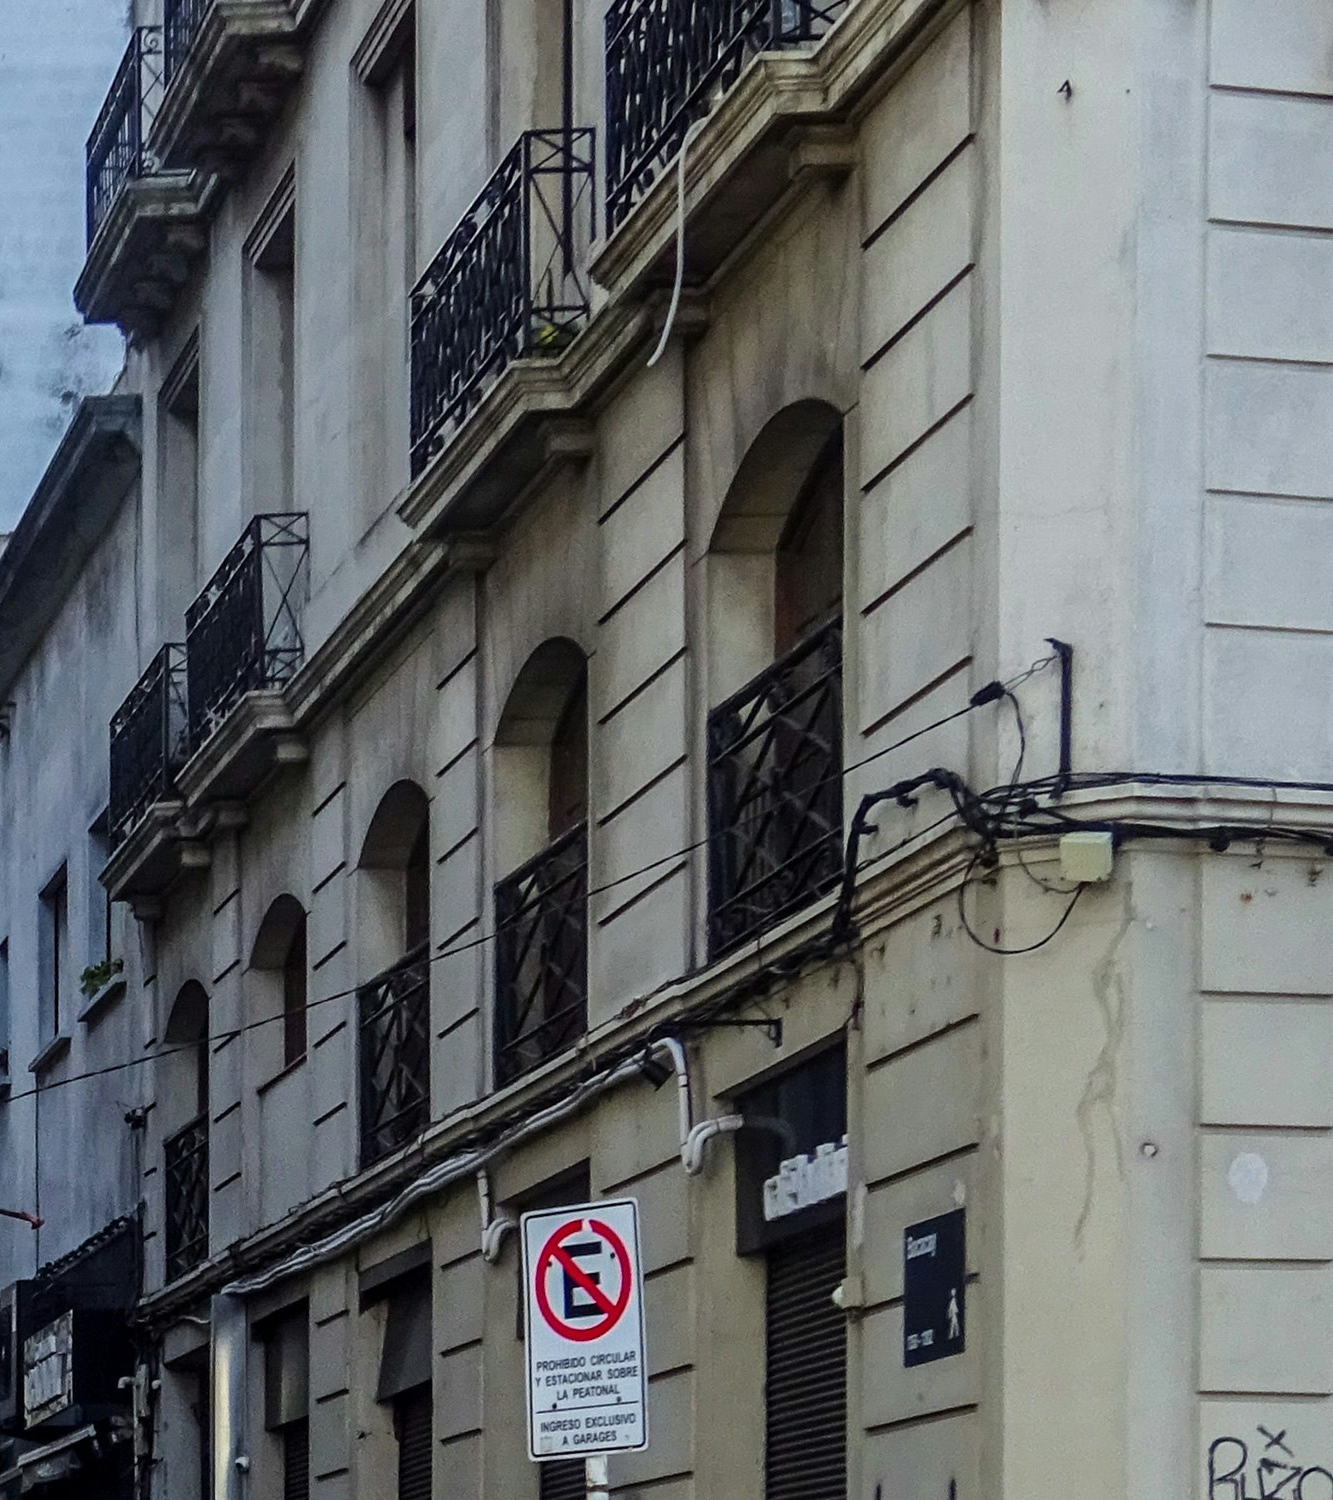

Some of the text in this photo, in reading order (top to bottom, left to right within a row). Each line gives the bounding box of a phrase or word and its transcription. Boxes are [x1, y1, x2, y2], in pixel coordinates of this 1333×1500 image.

[536, 1351, 636, 1372] PROHIBIDO CIRCULAR
[535, 1365, 638, 1388] Y ESTACIONAR SOBRE
[556, 1384, 620, 1401] LA PEATONAL
[540, 1413, 636, 1433] INGRESO EXCLUSIVO
[562, 1430, 617, 1446] A GARAGES
